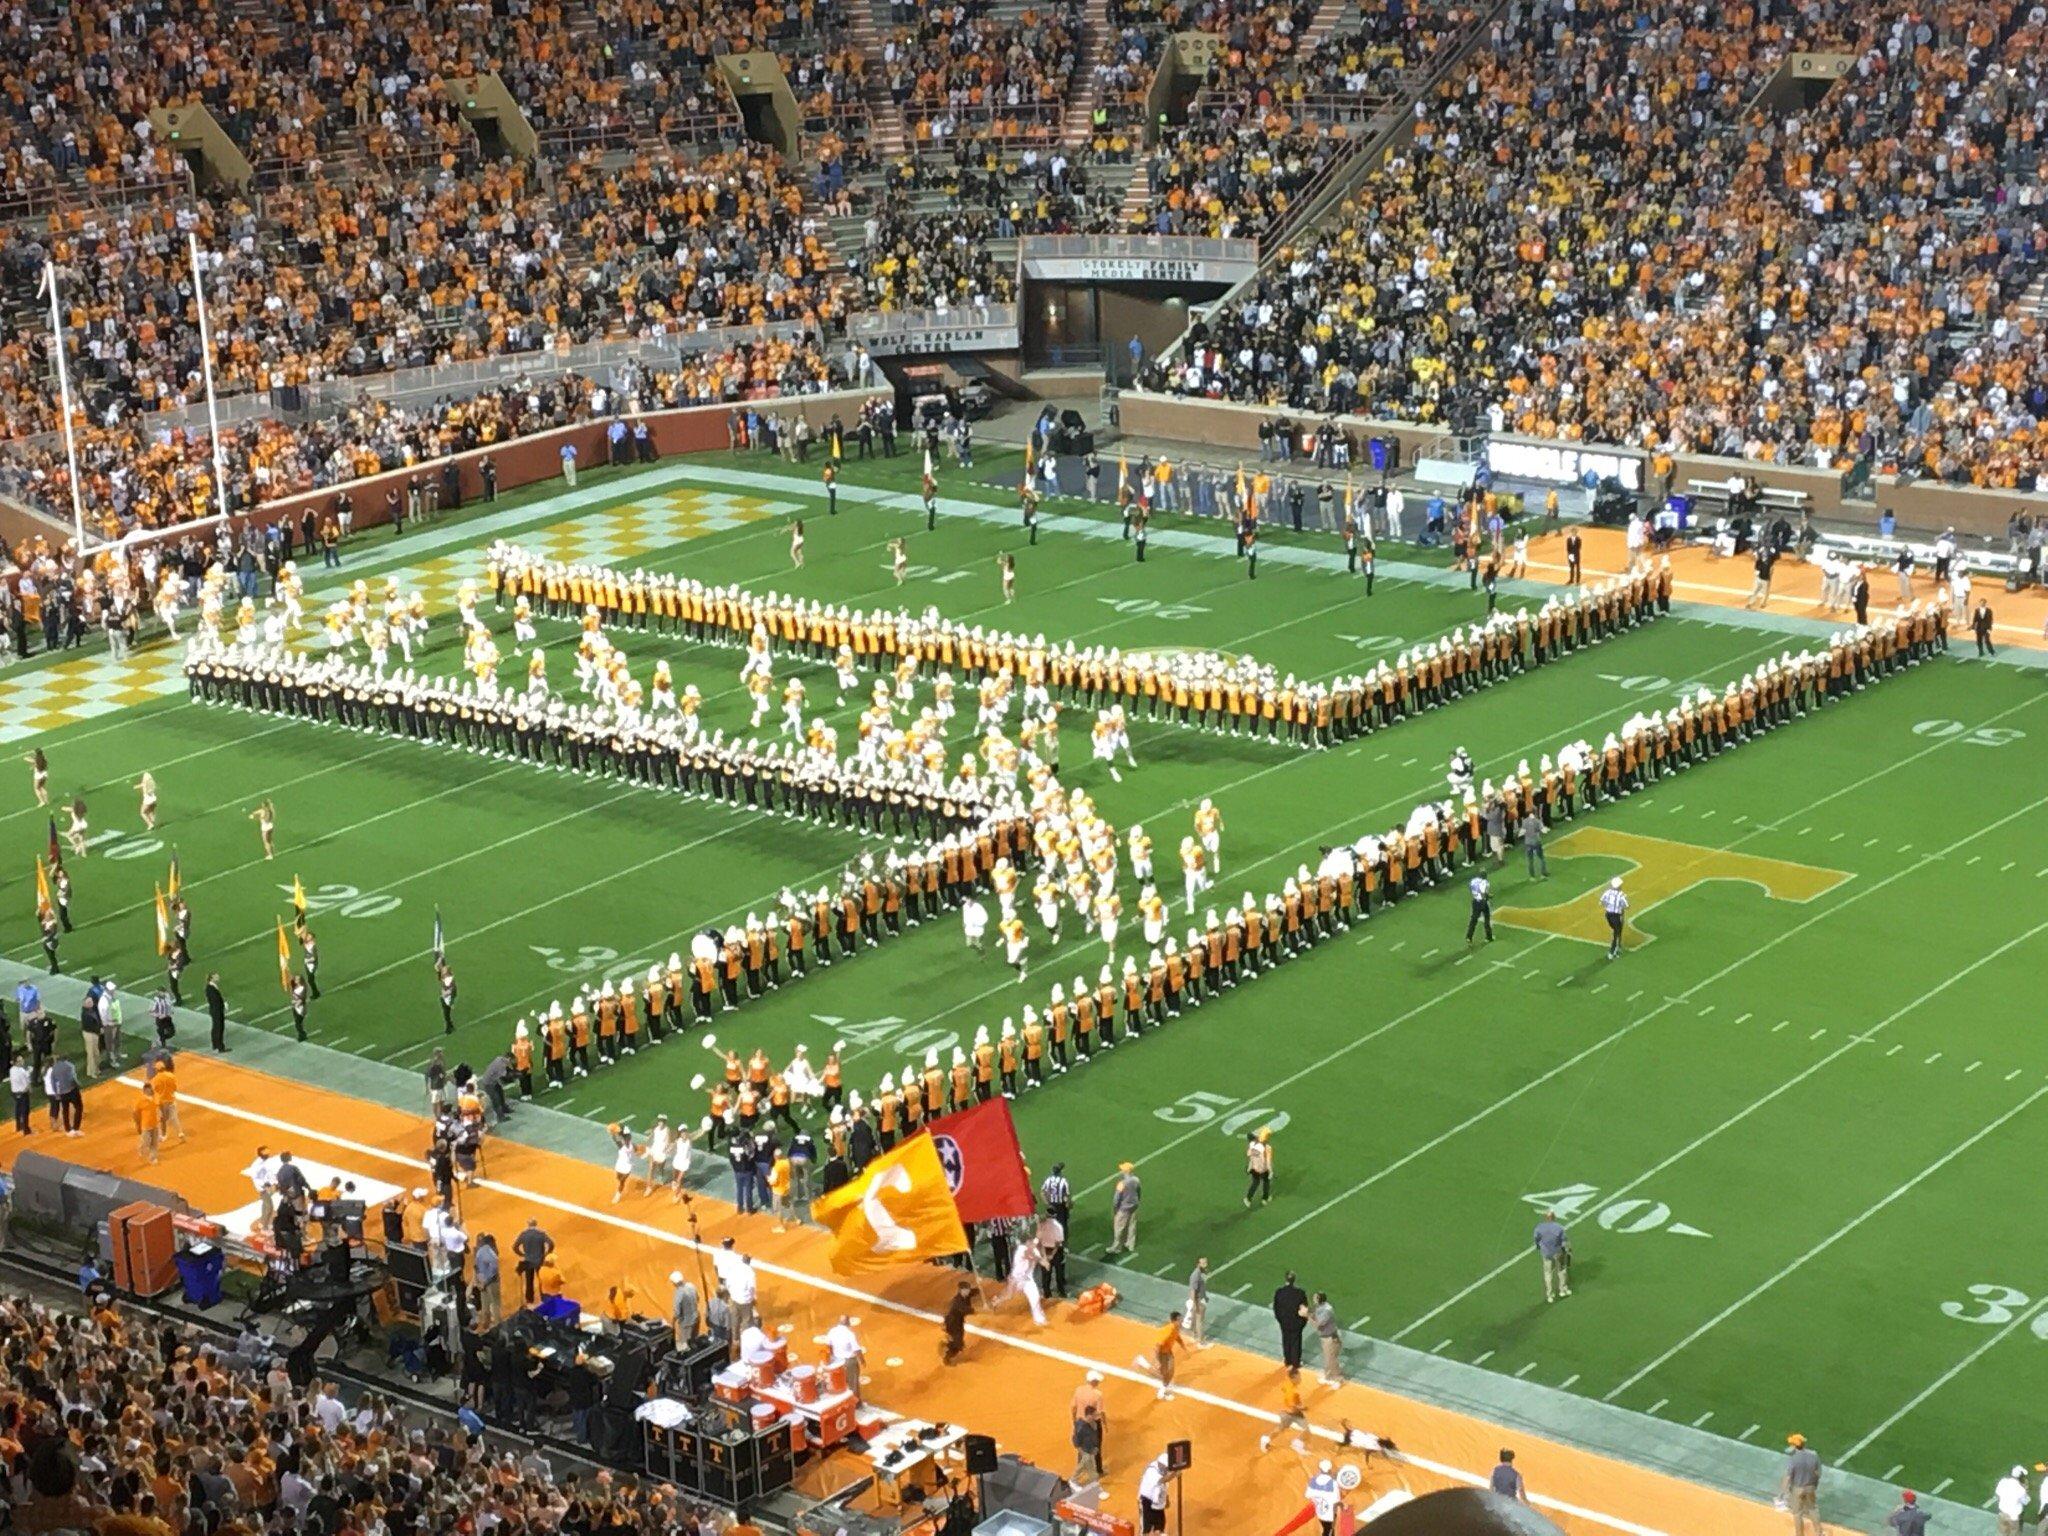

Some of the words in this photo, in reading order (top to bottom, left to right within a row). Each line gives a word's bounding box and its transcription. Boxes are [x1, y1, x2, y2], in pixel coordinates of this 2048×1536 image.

[1082, 259, 1141, 269] STOKELY
[1150, 260, 1199, 271] FAMILY
[1091, 269, 1134, 279] MEDIA
[1142, 269, 1193, 281] CENTER
[868, 334, 906, 347] WOLF
[924, 330, 984, 342] KAPLAN
[895, 341, 952, 354] CENTER
[1911, 719, 2027, 746] 50
[1491, 825, 1858, 952] T
[285, 883, 403, 919] 20
[836, 1015, 960, 1057] 40
[1152, 1091, 1291, 1139] 50
[1521, 1183, 1672, 1234] 40
[1940, 1283, 2048, 1341] 3
[679, 1435, 691, 1451] T
[709, 1442, 724, 1463] T
[767, 1432, 782, 1453] T
